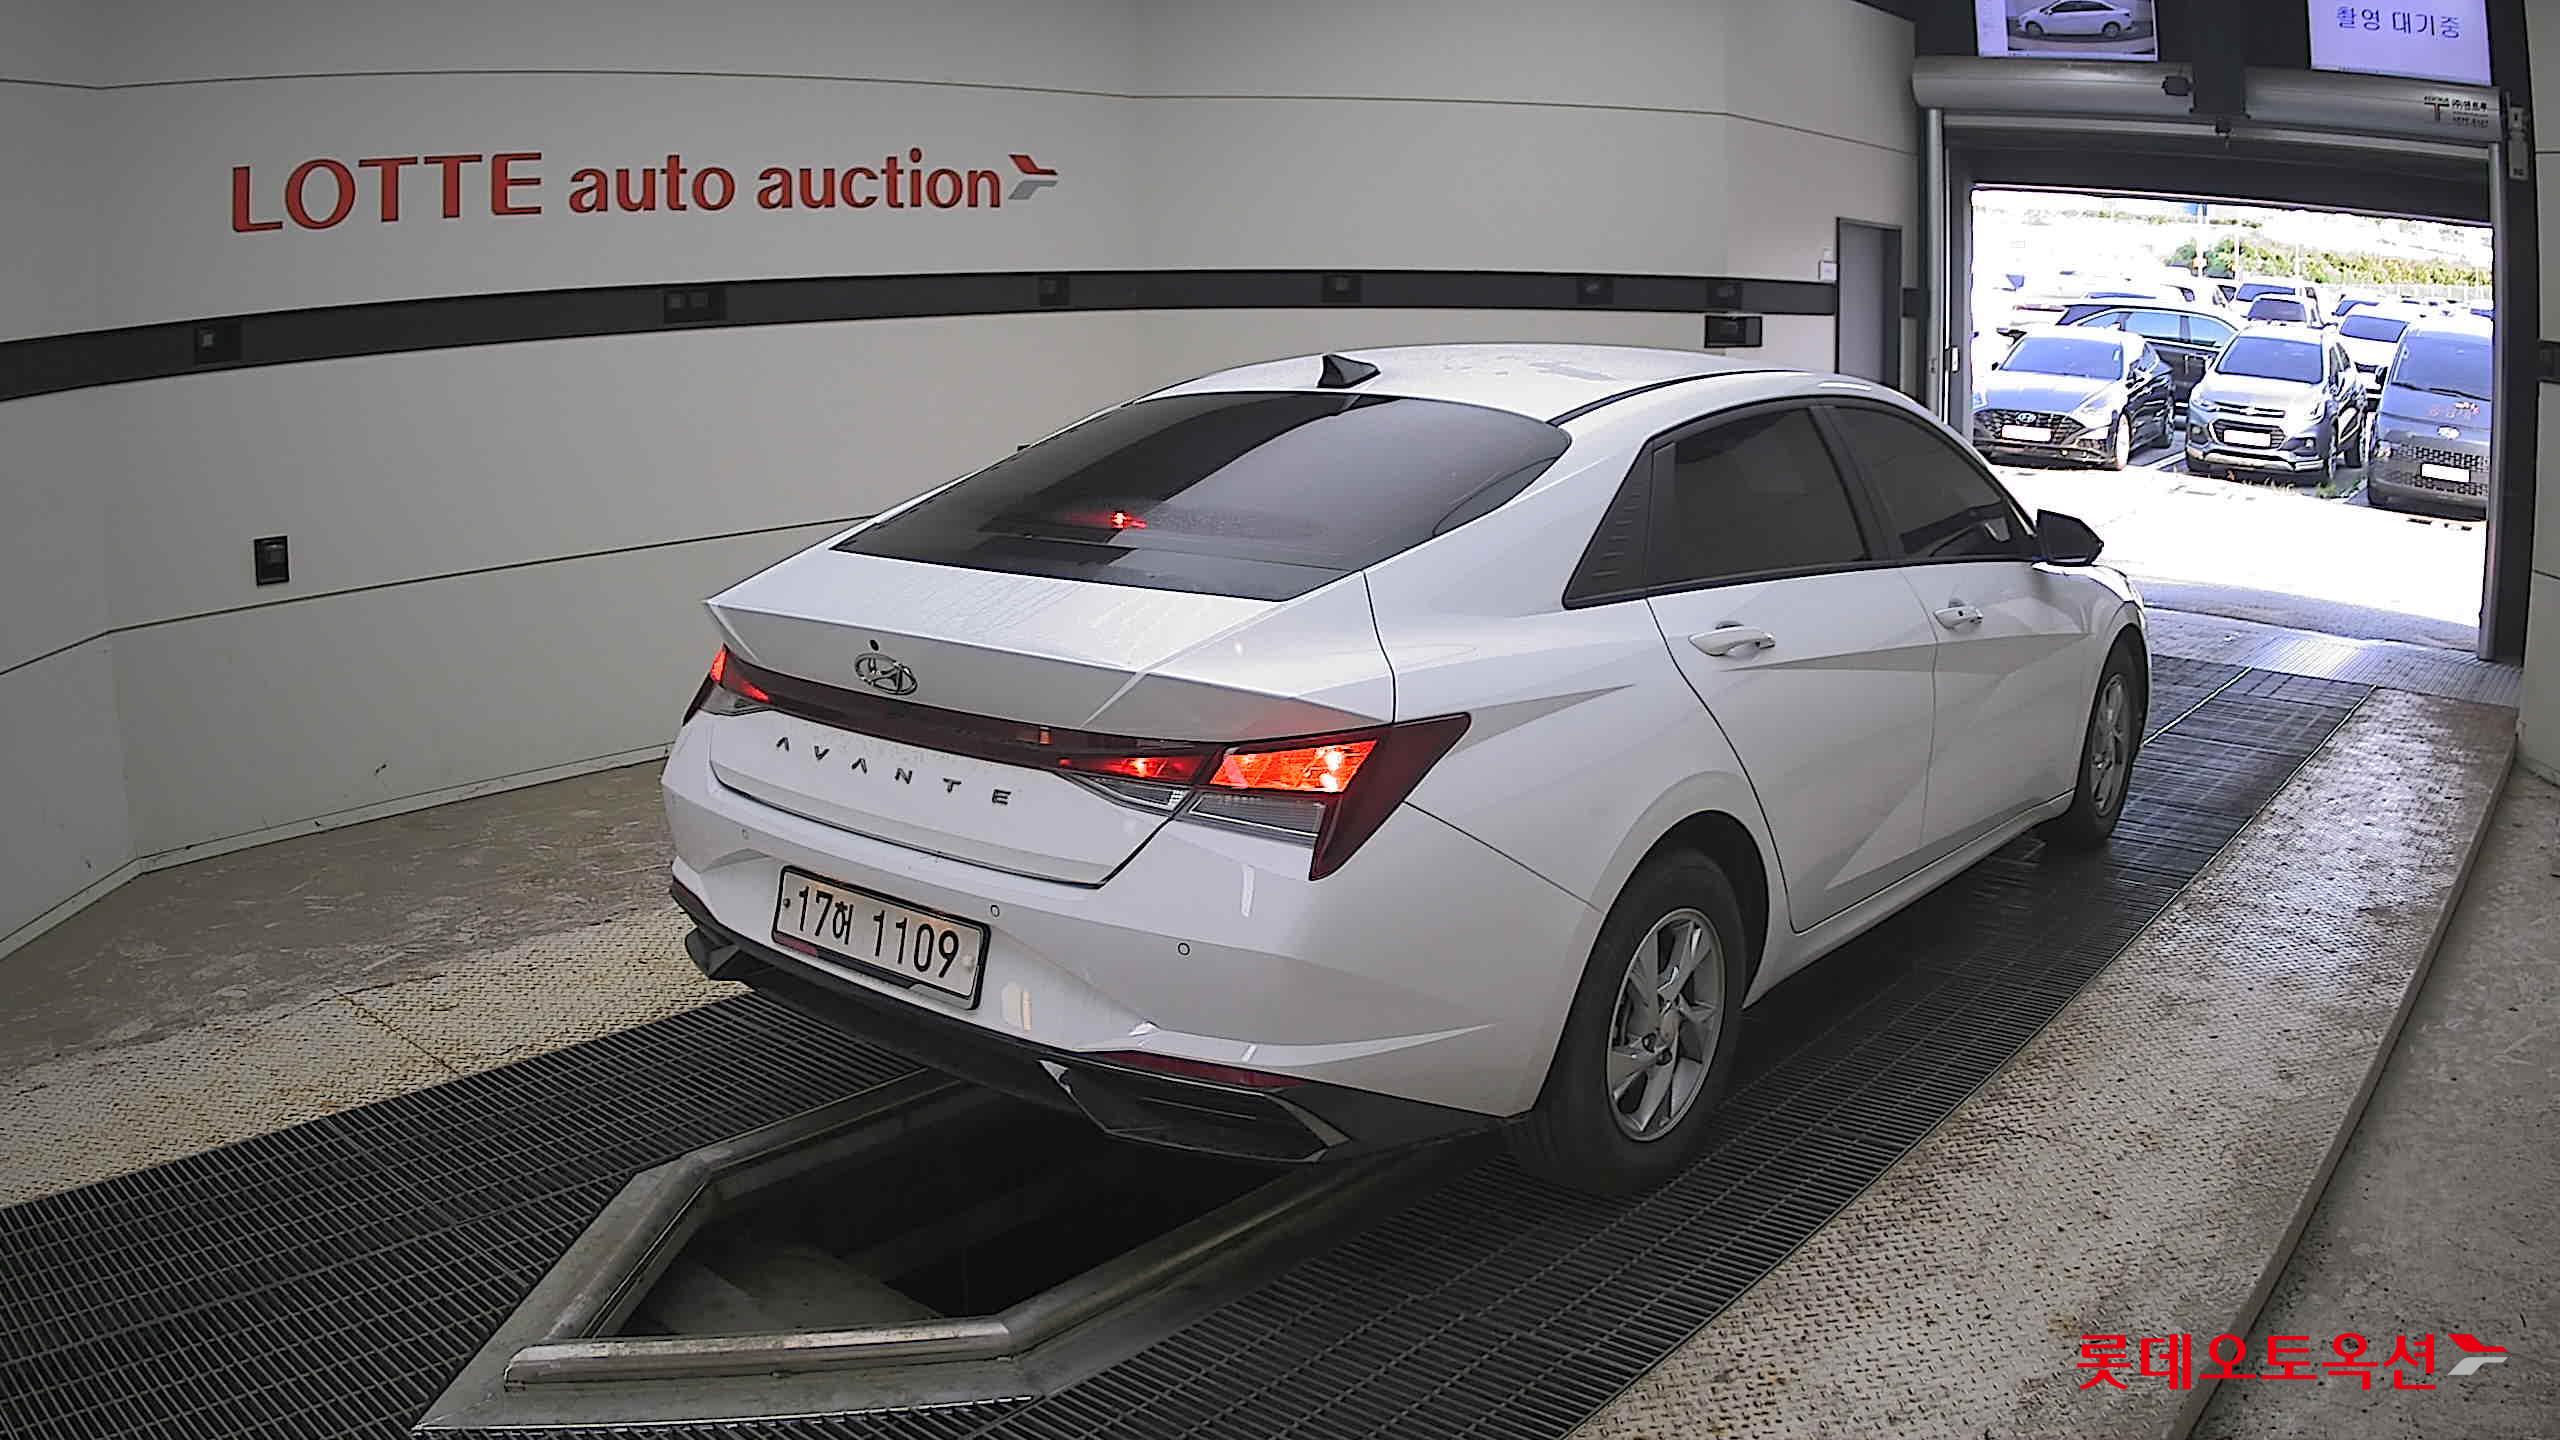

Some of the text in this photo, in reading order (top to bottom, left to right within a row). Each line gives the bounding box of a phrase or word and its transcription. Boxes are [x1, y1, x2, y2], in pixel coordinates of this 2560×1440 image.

[2336, 6, 2461, 39] 촬영 대기중
[231, 149, 1003, 232] LOTTE auto auction
[775, 736, 1013, 807] AVANTE
[797, 885, 960, 979] 17허 1109
